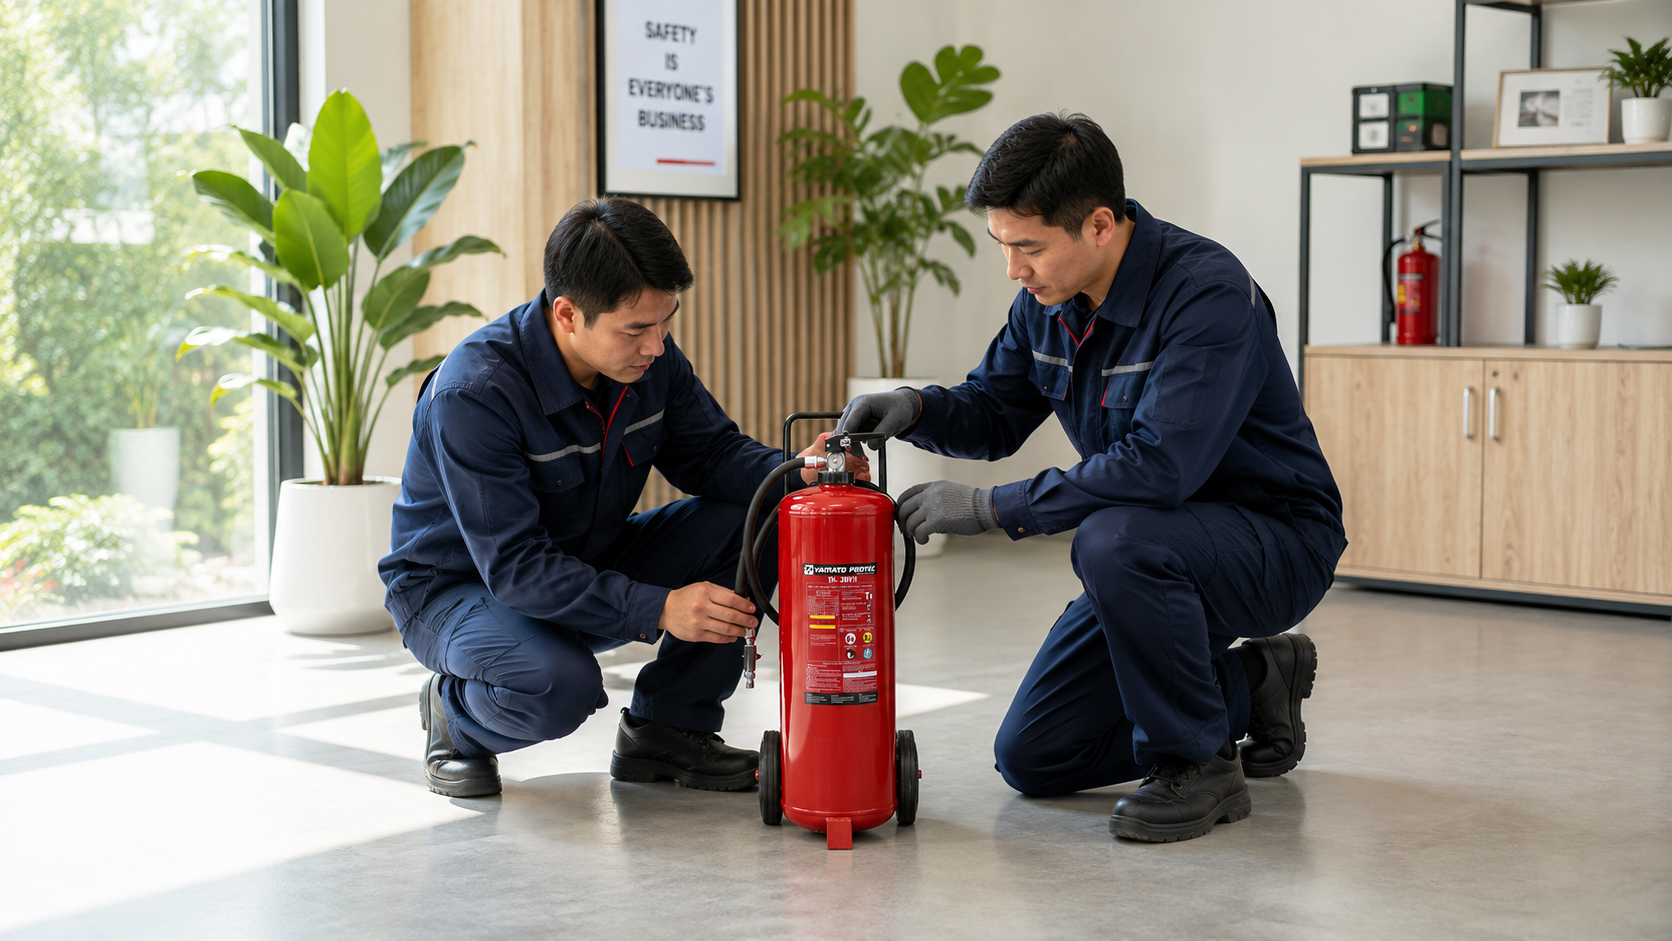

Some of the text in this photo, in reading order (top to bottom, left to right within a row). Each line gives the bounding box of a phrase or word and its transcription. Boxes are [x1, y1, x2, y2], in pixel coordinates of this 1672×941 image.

[645, 21, 698, 44] SAFETY
[665, 53, 679, 71] IS
[628, 78, 714, 104] EVERYONE'S
[638, 109, 705, 132] BUSINESS
